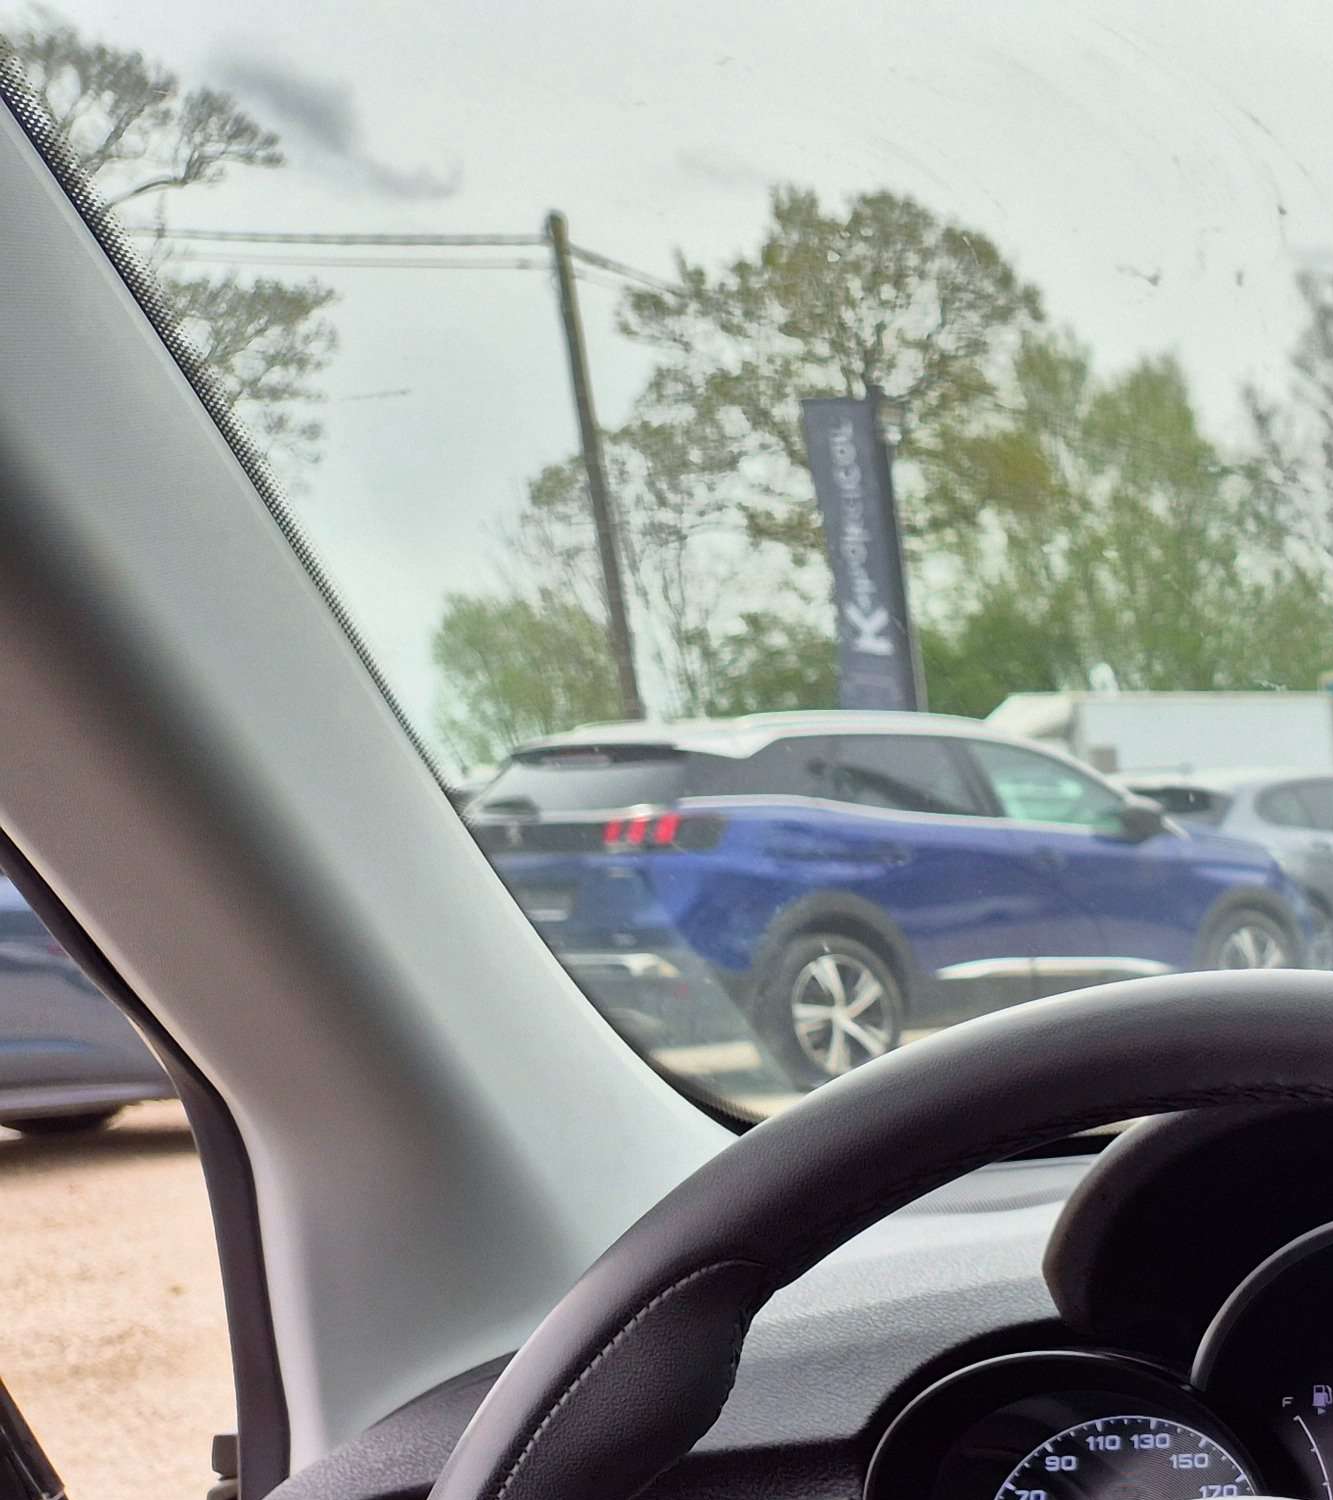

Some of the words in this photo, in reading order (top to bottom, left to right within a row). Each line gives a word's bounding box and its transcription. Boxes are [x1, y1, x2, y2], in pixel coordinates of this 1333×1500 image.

[1282, 1396, 1294, 1407] F
[1086, 1435, 1121, 1451] 110
[1131, 1434, 1170, 1449] 130
[1045, 1455, 1077, 1471] 90
[1170, 1453, 1209, 1469] 150
[1200, 1484, 1238, 1498] 170
